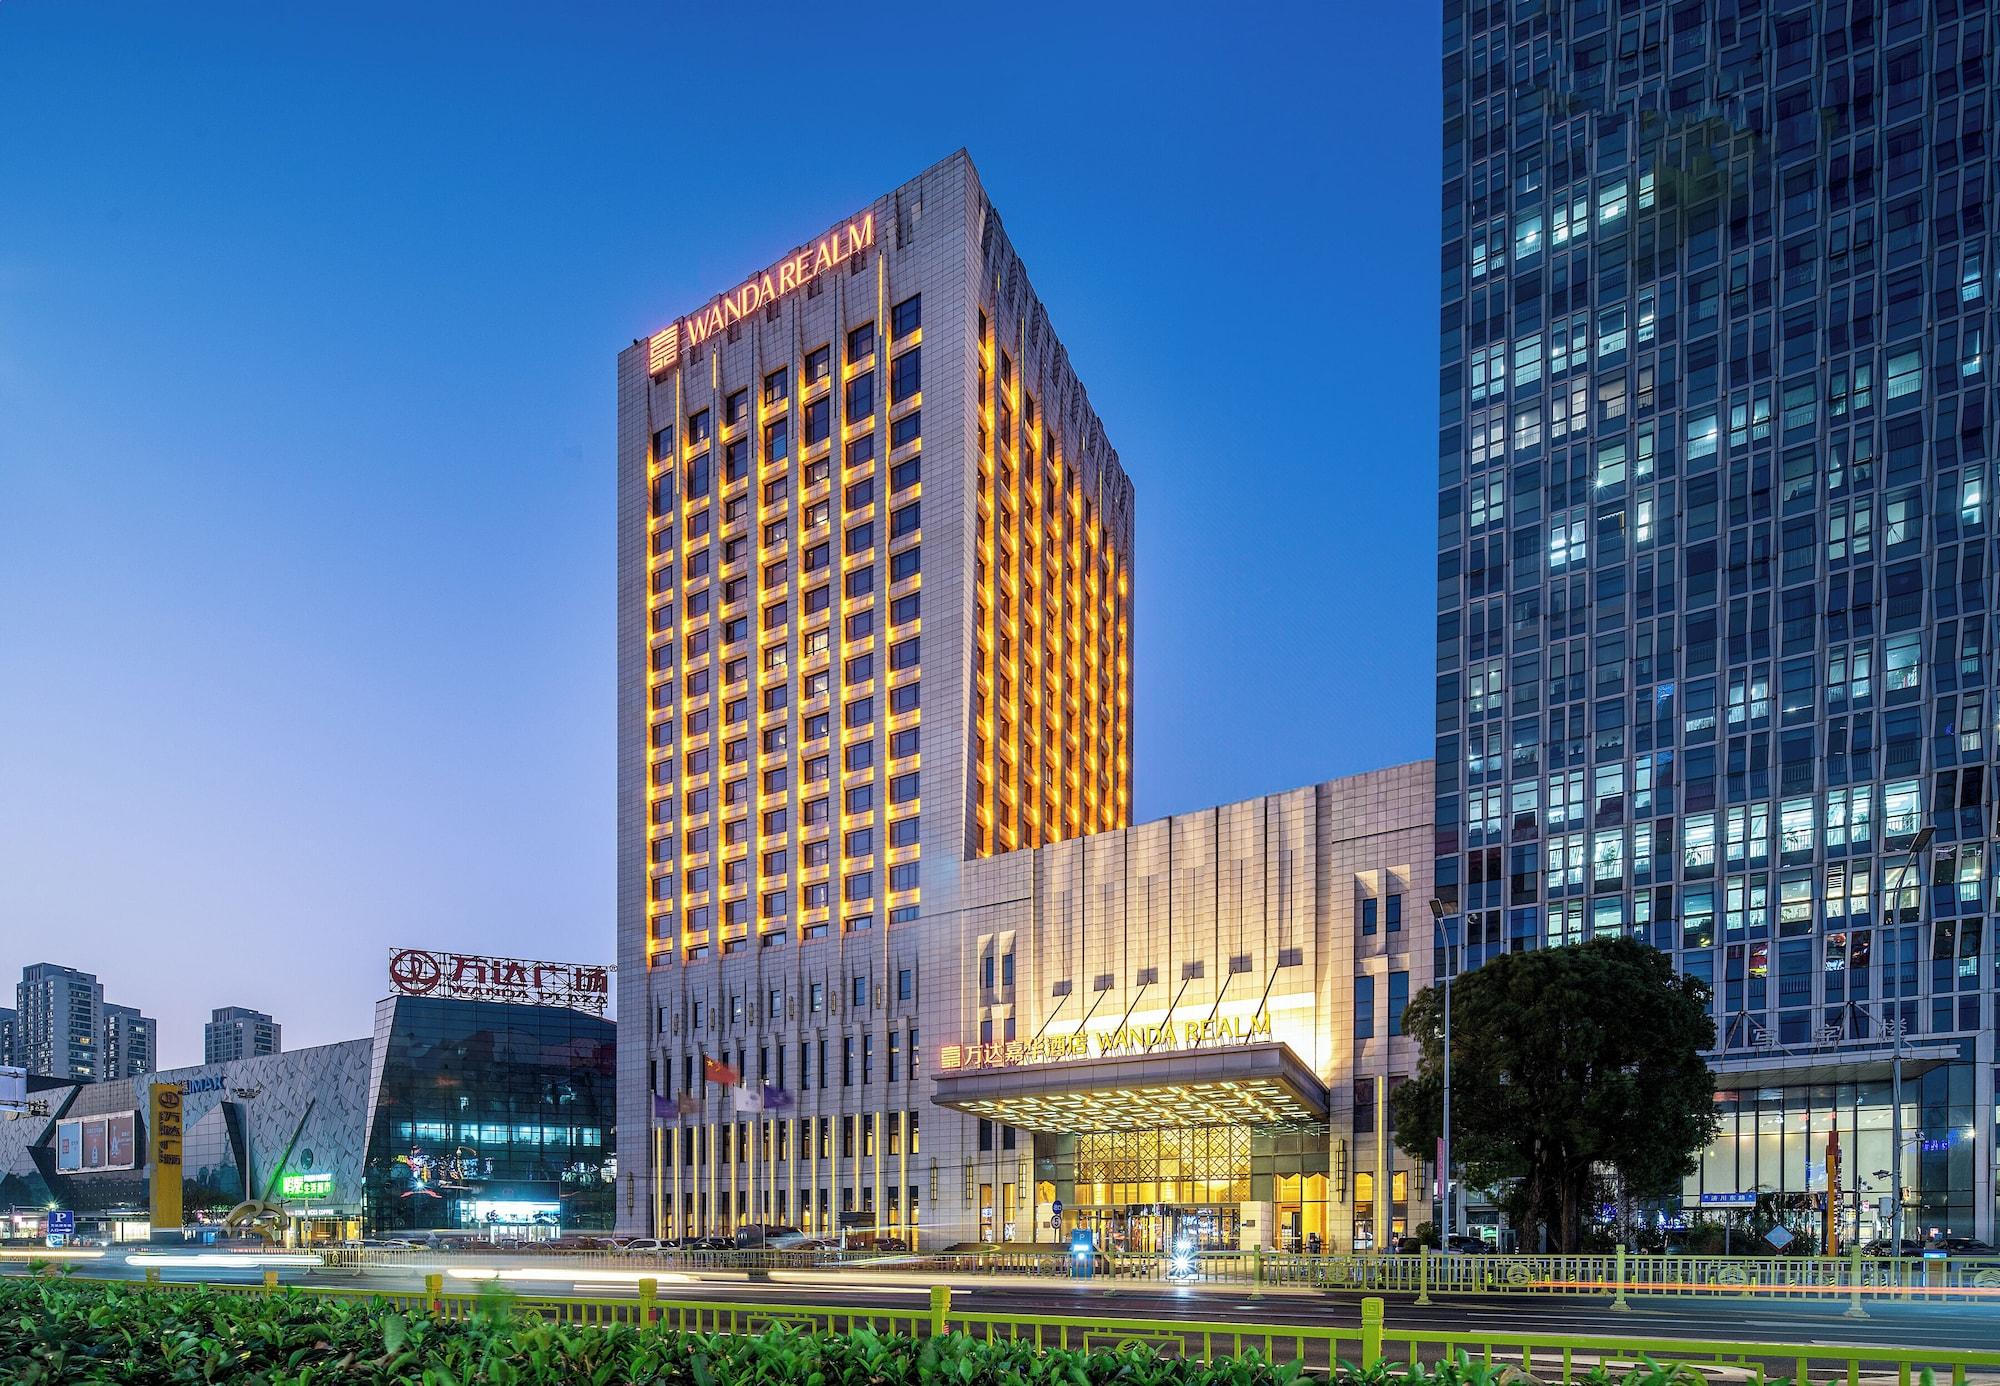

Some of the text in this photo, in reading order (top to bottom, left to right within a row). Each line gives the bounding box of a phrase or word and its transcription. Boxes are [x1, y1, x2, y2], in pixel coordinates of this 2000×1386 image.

[687, 214, 875, 346] WANDA REALM
[451, 955, 608, 994] 万达广场
[964, 1032, 1089, 1066] 万达嘉华酒店
[1096, 1013, 1271, 1050] WANDA REALM
[55, 1212, 66, 1223] P
